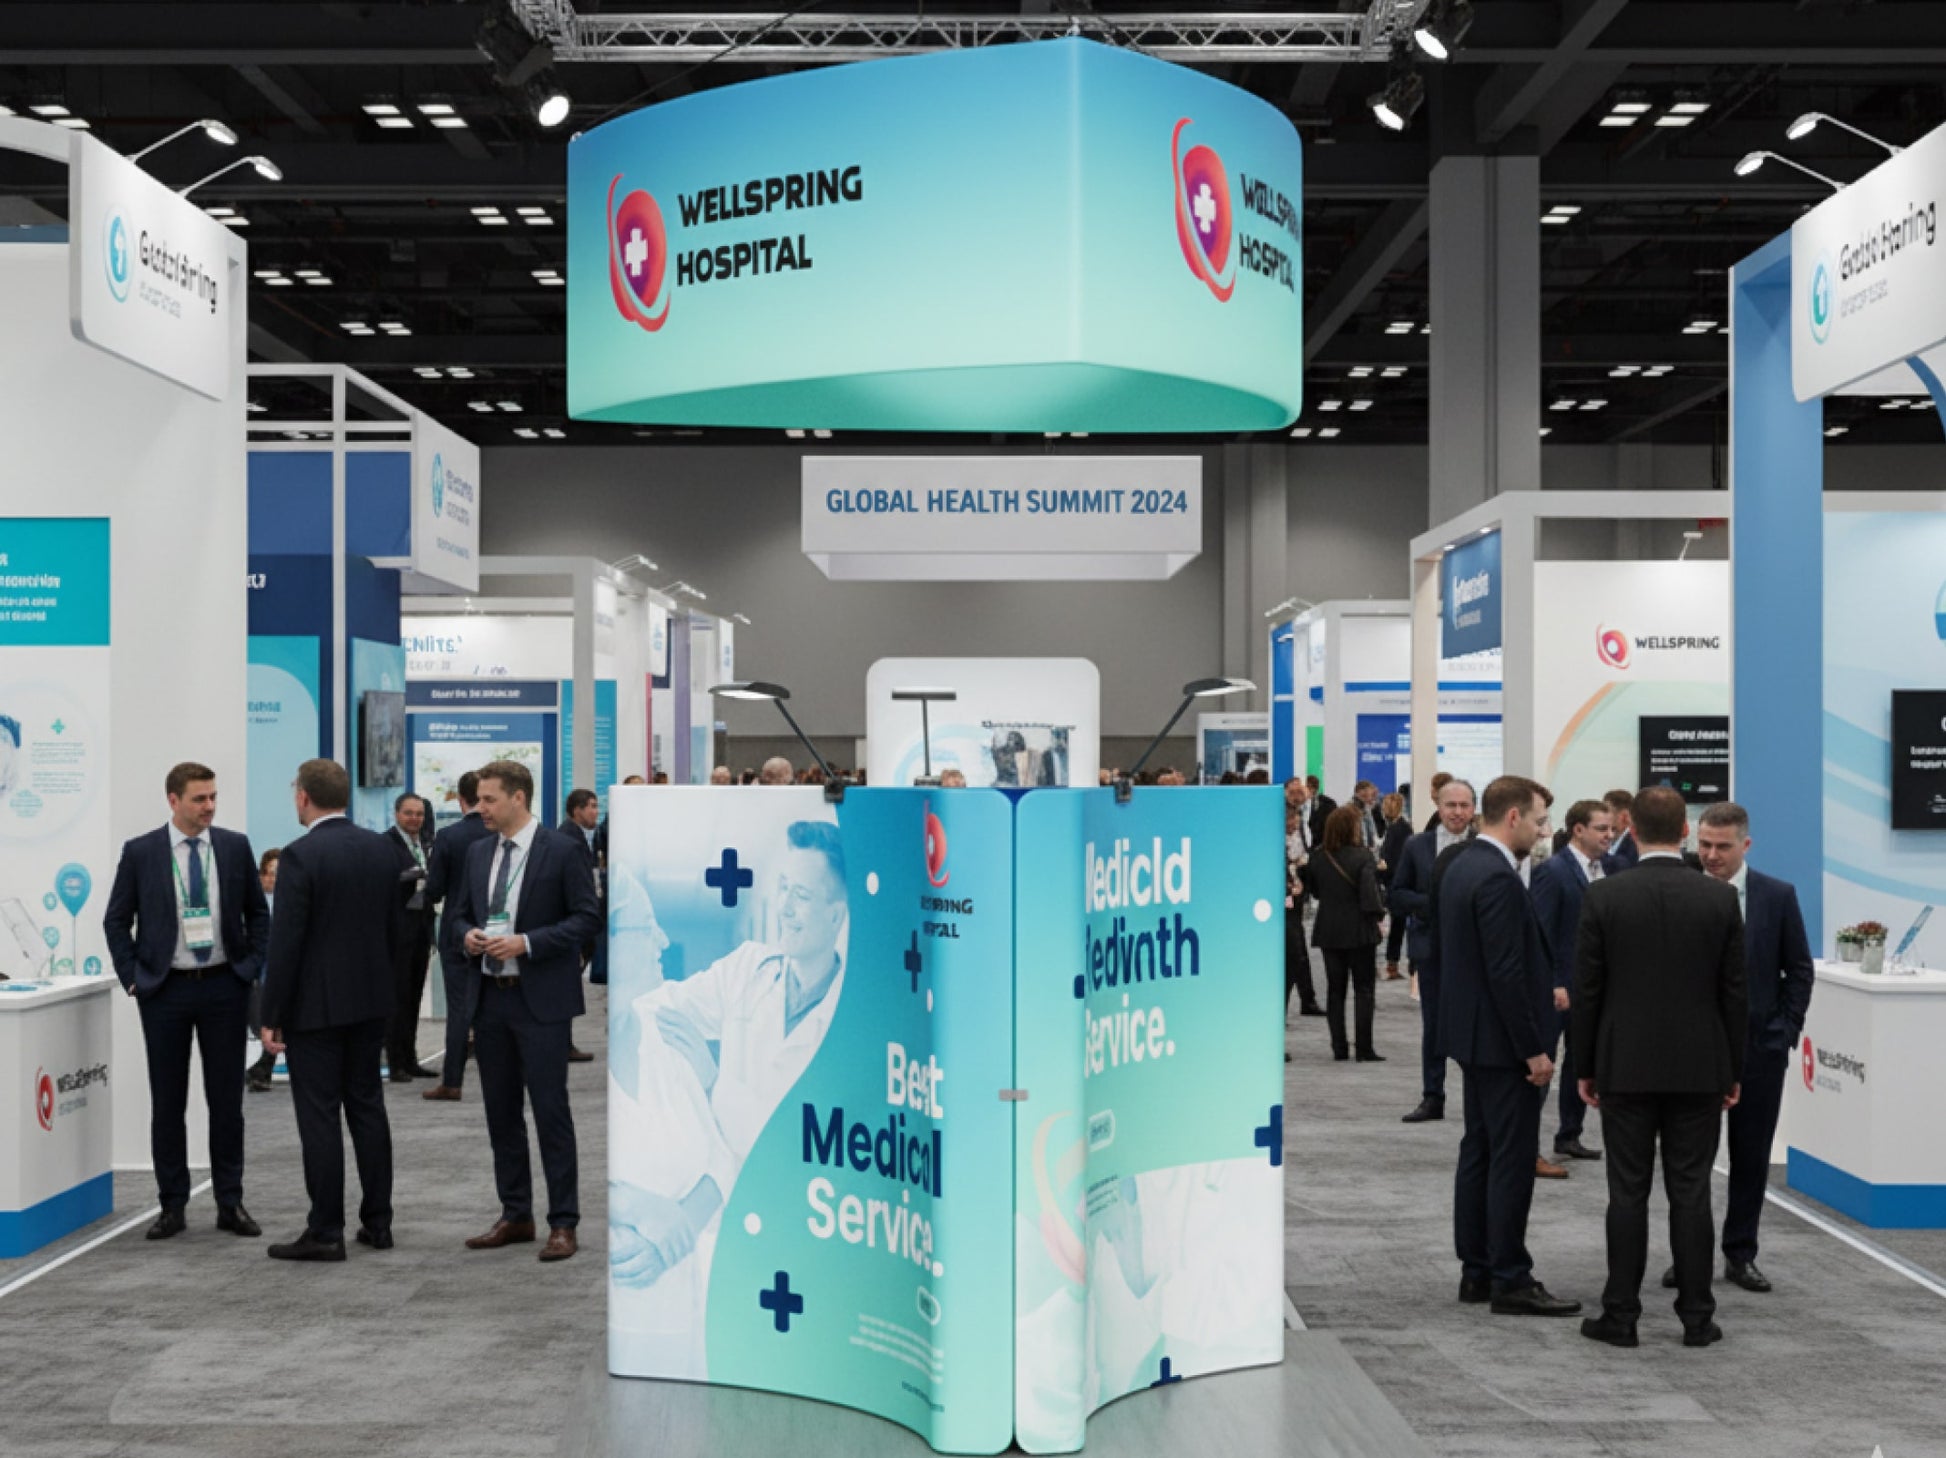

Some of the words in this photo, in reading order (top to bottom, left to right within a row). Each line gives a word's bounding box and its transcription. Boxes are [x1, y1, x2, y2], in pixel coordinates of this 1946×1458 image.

[678, 165, 862, 228] WELLSPRING
[677, 234, 813, 287] HOSPITAL
[826, 489, 919, 513] GLOBAL
[928, 489, 1019, 513] HEALTH
[1026, 489, 1125, 513] SUMMIT
[1130, 489, 1188, 513] 2024
[1635, 636, 1720, 649] WELLSPRING
[887, 1041, 944, 1119] Best
[802, 1103, 942, 1198] Medical
